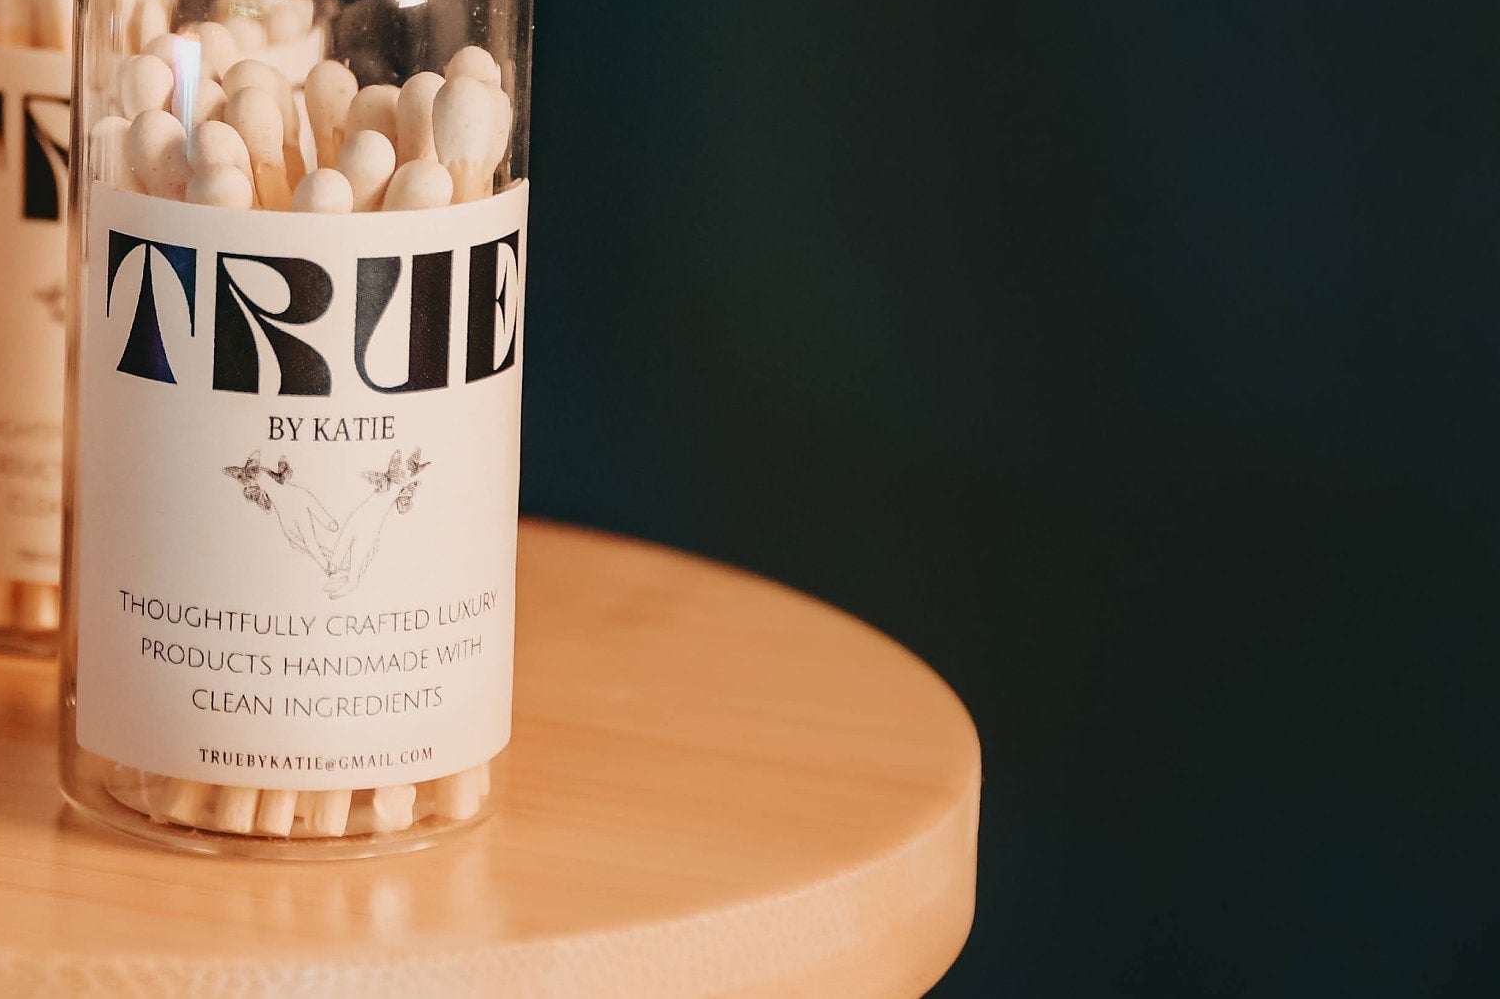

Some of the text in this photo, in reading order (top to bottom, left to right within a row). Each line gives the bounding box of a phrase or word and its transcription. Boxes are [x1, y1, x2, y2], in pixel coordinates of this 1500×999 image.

[107, 229, 519, 396] TRUE
[268, 415, 395, 442] BY KATIE
[118, 589, 498, 636] THOUGHTFULLY CRAFTED LUXURY
[141, 635, 482, 677] PRODUCTS HANDMADE WITH
[192, 686, 443, 719] CLEAN INGREDIENTS
[199, 747, 433, 771] TRUEBYKATIE@GMAIL.COM
